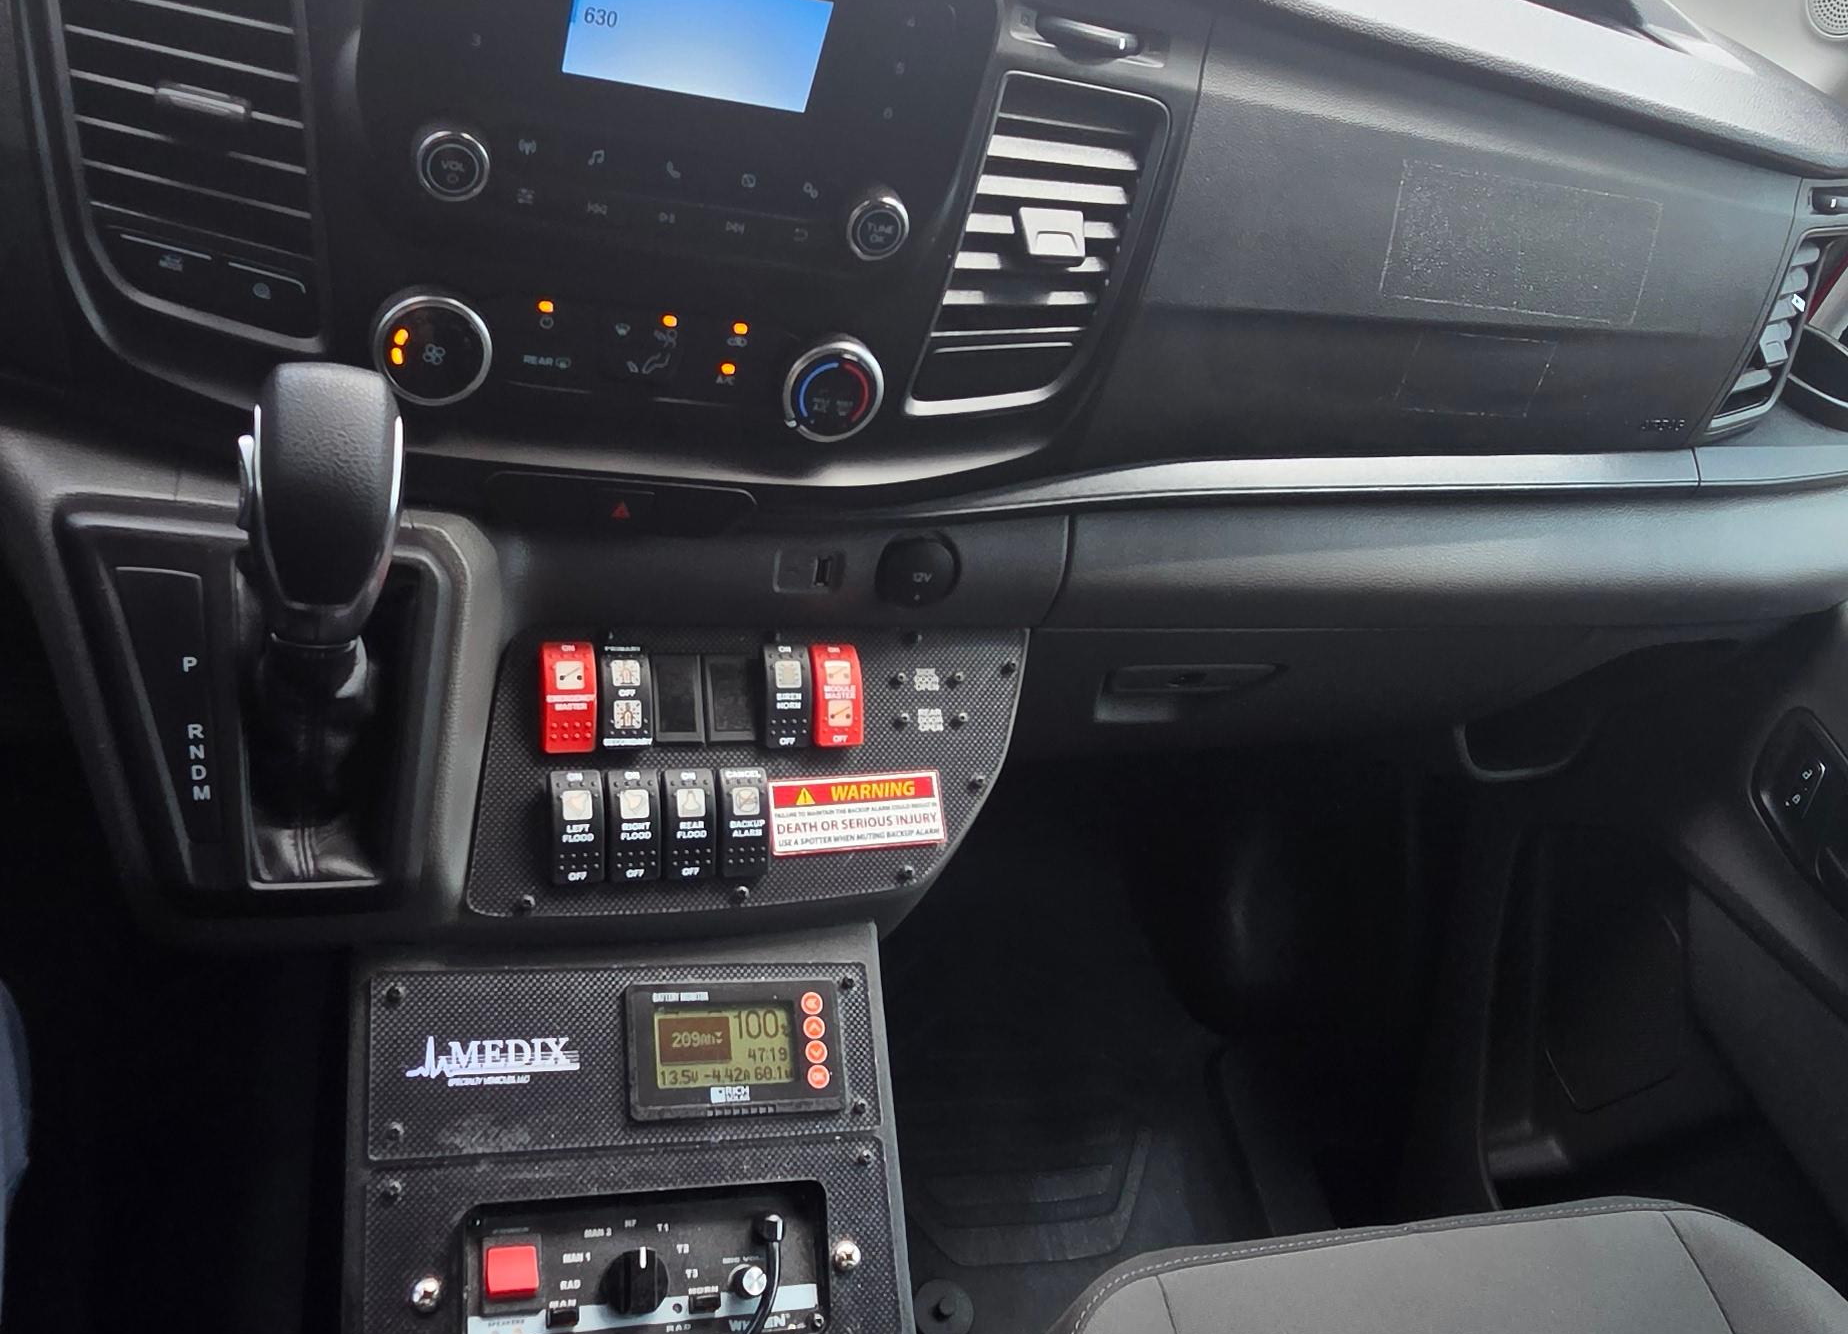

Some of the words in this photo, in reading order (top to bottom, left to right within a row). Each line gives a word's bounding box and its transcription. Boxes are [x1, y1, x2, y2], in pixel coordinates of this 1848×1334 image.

[584, 6, 618, 28] 630
[523, 355, 553, 367] REAR
[716, 376, 735, 386] A/C
[913, 571, 932, 583] 12V
[183, 656, 198, 672] P
[618, 688, 636, 697] OFF
[187, 723, 204, 739] R
[779, 737, 796, 746] OFF
[832, 734, 849, 743] OFF
[189, 745, 205, 759] N
[191, 765, 207, 780] D
[566, 772, 583, 782] ON
[624, 771, 640, 781] ON
[680, 771, 697, 781] ON
[725, 770, 762, 779] CANCEL
[193, 785, 211, 801] M
[831, 780, 916, 802] WARNING
[621, 822, 651, 831] RIGHT
[679, 820, 704, 830] REAR
[729, 819, 766, 829] BACKUP
[777, 821, 818, 835] DEATH
[821, 819, 839, 831] OR
[841, 815, 893, 830] SERIOUS
[895, 811, 937, 826] INJURY
[566, 824, 590, 834] LEFT
[676, 829, 707, 839] FLOOD
[732, 828, 763, 838] ALARM
[562, 833, 594, 843] FLOOD
[620, 831, 652, 841] FLOOD
[778, 839, 793, 847] USE
[800, 836, 832, 845] SPOTTER
[833, 834, 855, 843] WHEN
[857, 831, 885, 841] MUTING
[886, 829, 914, 839] BACKUP
[915, 827, 939, 836] ALARM
[567, 871, 587, 881] OFF
[625, 869, 645, 878] OFF
[681, 866, 700, 876] OFF
[448, 1037, 569, 1069] MEDIX
[660, 1069, 698, 1086] 13.5V
[656, 1223, 670, 1233] T1
[562, 1253, 584, 1264] MAN
[559, 1279, 582, 1291] RAD
[688, 1285, 719, 1296] HORN
[728, 1313, 786, 1332] WHEN
[666, 1323, 692, 1333] RAD
